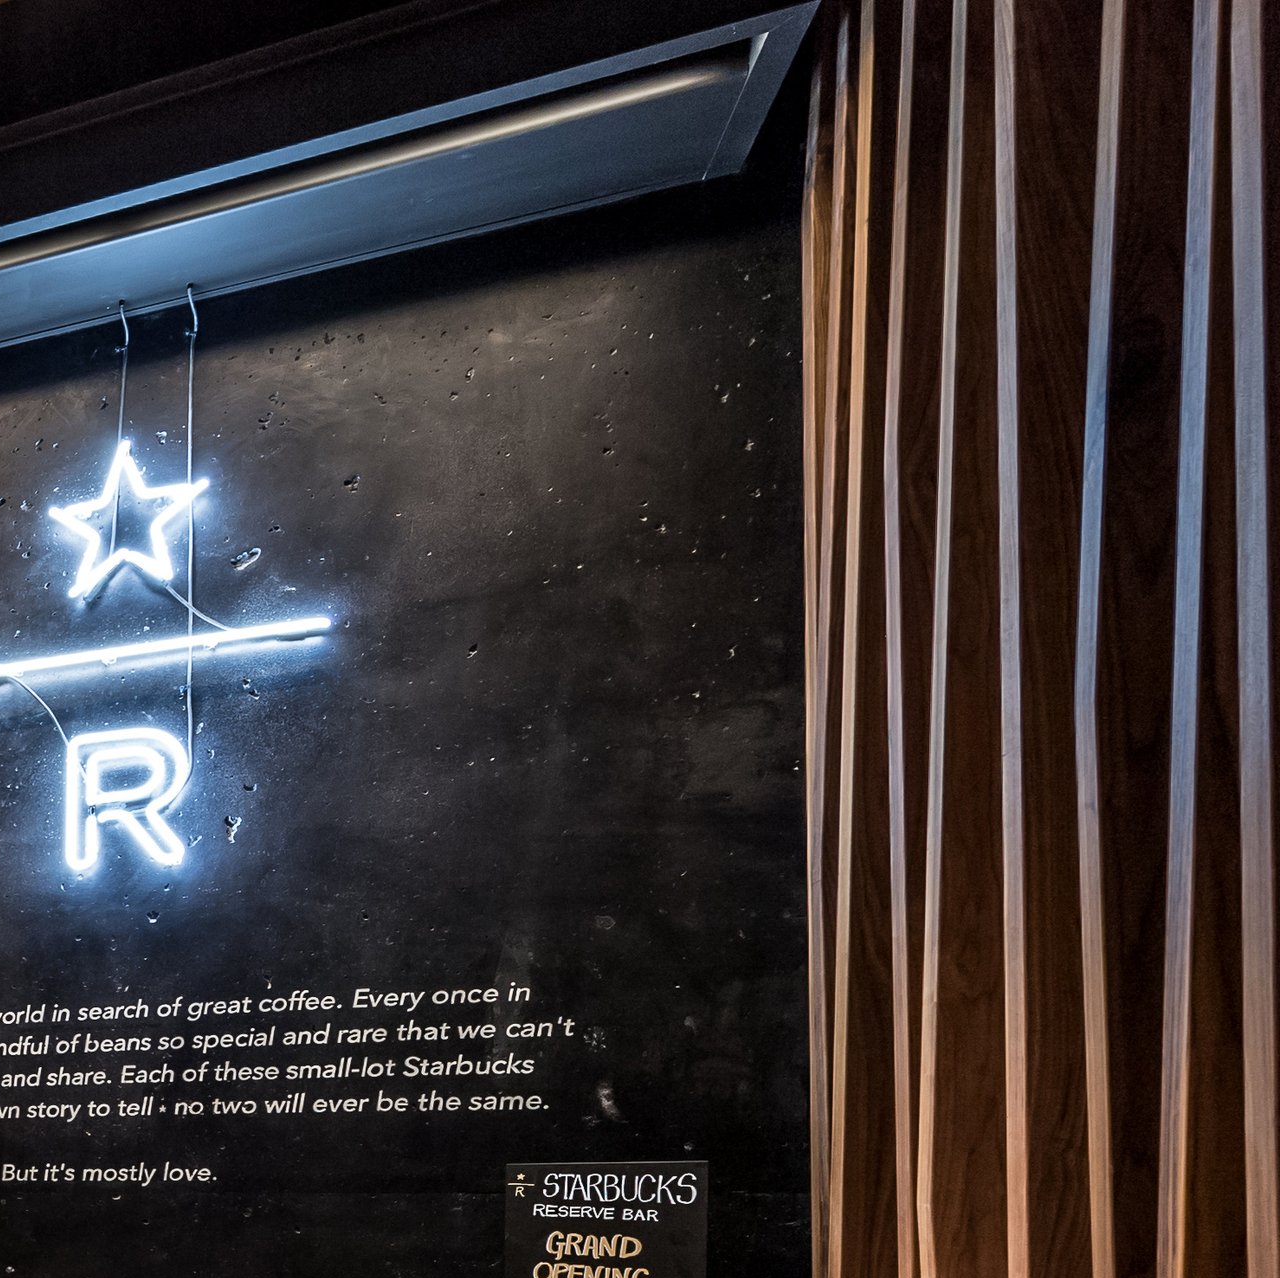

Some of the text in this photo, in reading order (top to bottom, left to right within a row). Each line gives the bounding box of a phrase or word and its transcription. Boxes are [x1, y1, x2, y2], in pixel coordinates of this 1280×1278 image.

[64, 727, 190, 870] R
[51, 1003, 71, 1022] in
[77, 998, 150, 1021] search
[156, 996, 184, 1017] of
[187, 997, 253, 1022] great
[258, 989, 342, 1013] coffee.
[352, 987, 426, 1012] Every
[431, 988, 499, 1005] once
[507, 982, 531, 1002] in
[55, 1034, 81, 1054] of
[83, 1031, 152, 1054] beans
[157, 1036, 186, 1051] so
[192, 1026, 276, 1054] special
[282, 1023, 331, 1046] and
[336, 1028, 388, 1044] rare
[396, 1020, 451, 1042] that
[457, 1024, 497, 1040] we
[505, 1016, 575, 1038] can't
[1, 1067, 43, 1088] and
[46, 1065, 112, 1087] share.
[119, 1063, 176, 1085] Each
[182, 1060, 210, 1083] of
[213, 1061, 280, 1082] these
[286, 1056, 397, 1080] small-lot
[403, 1052, 535, 1077] Starbucks
[27, 1102, 82, 1122] story
[87, 1101, 111, 1118] to
[117, 1096, 154, 1117] tell
[174, 1101, 204, 1115] no
[211, 1099, 257, 1115] two
[264, 1092, 306, 1114] will
[312, 1098, 370, 1113] ever
[376, 1089, 409, 1112] be
[417, 1090, 462, 1112] the
[468, 1092, 549, 1111] same.
[1, 1164, 39, 1182] But
[43, 1163, 75, 1182] it's
[82, 1161, 156, 1186] mostly
[163, 1161, 217, 1181] love.
[542, 1172, 698, 1205] STARBUCKS
[533, 1203, 659, 1222] RESERVE BAR
[545, 1230, 642, 1260] GRAND
